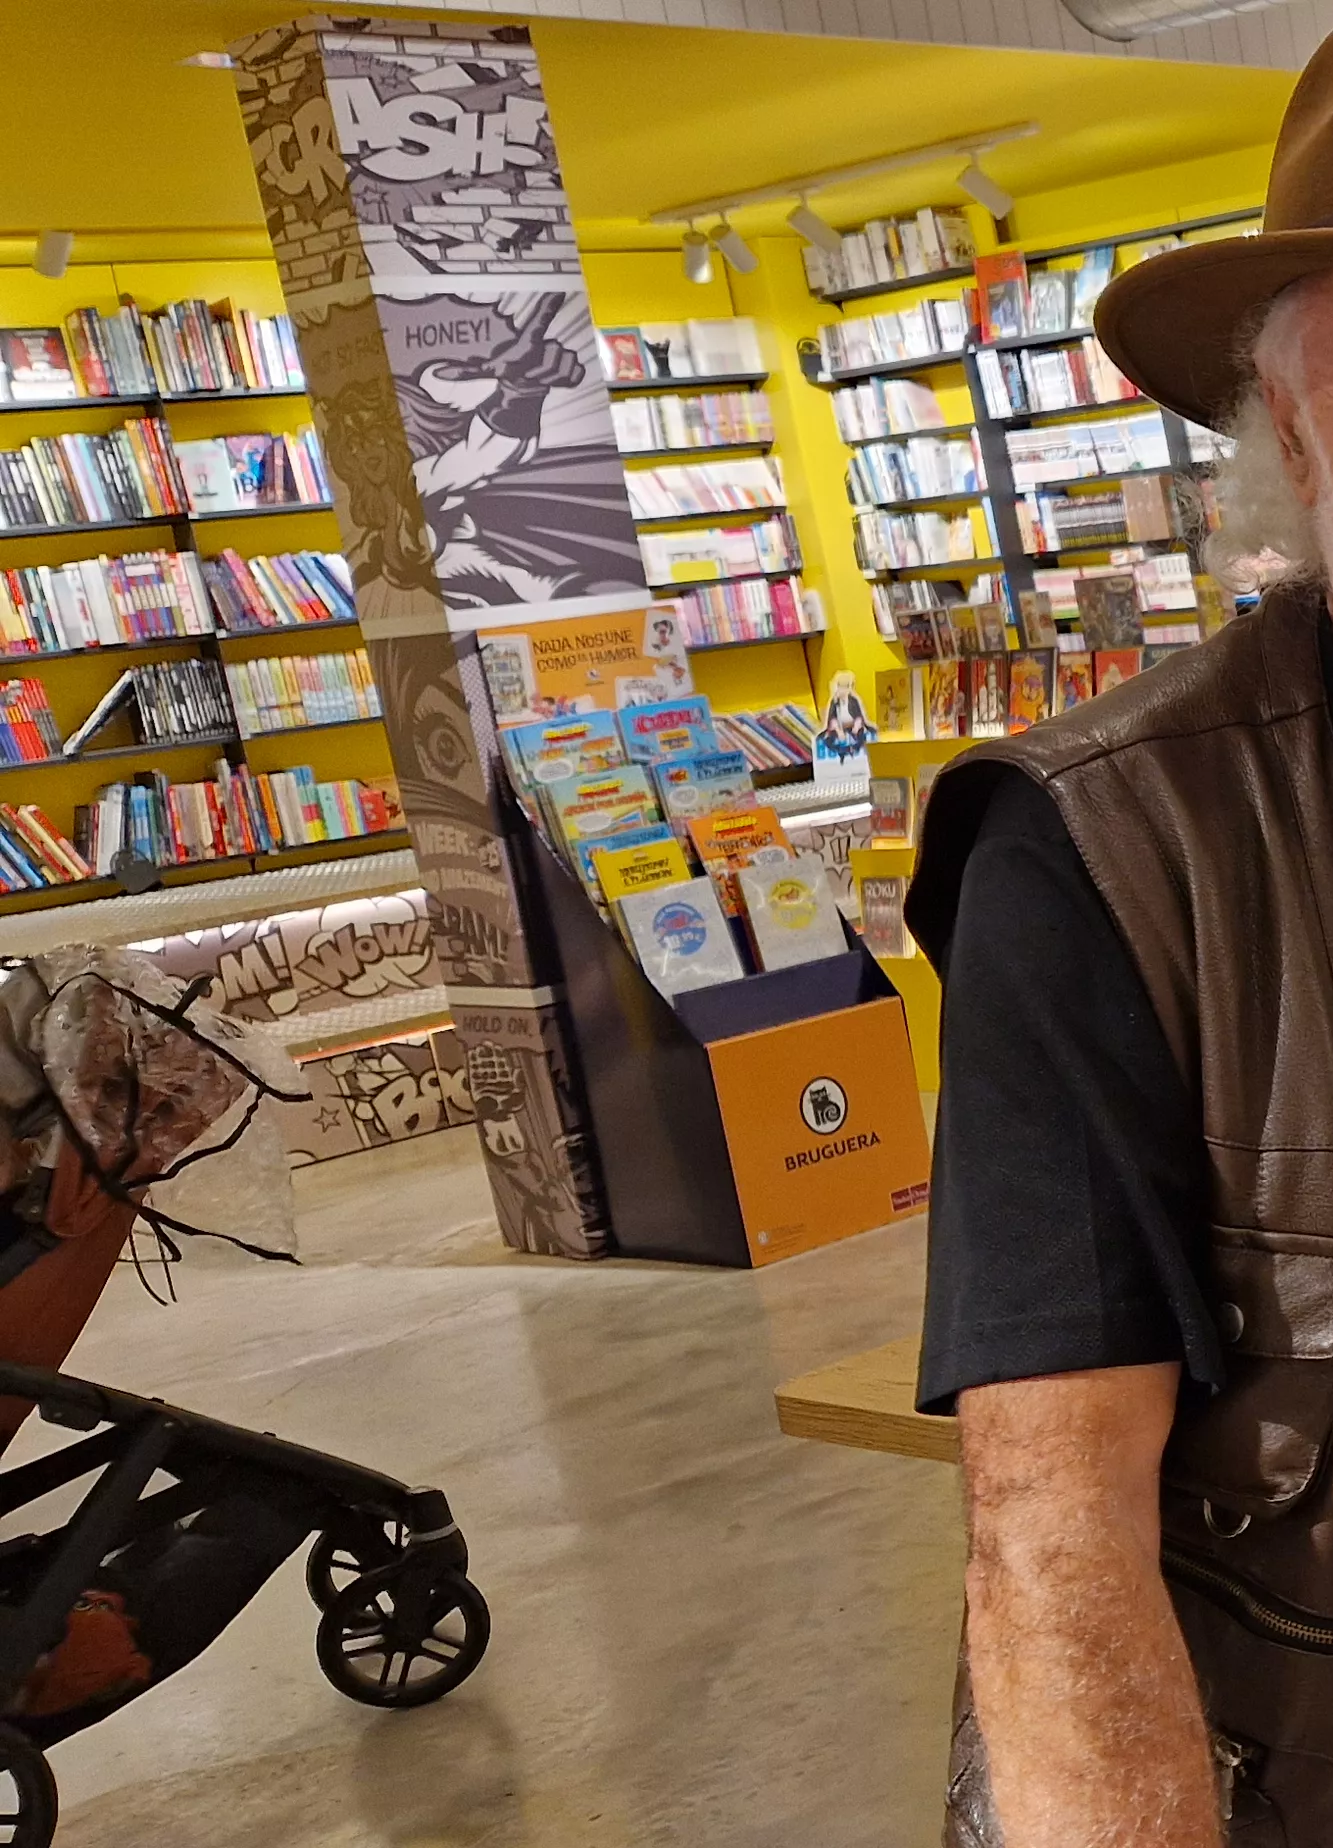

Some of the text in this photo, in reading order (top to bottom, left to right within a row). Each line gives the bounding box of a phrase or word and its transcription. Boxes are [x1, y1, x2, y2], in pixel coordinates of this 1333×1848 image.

[405, 317, 491, 349] HONEY!
[533, 629, 634, 655] NADA NOS UNE
[537, 647, 638, 673] COMO HUMOR
[296, 918, 431, 990] WOW!
[461, 1015, 534, 1036] HOLD ON,
[784, 1131, 882, 1172] BRUGUERA
